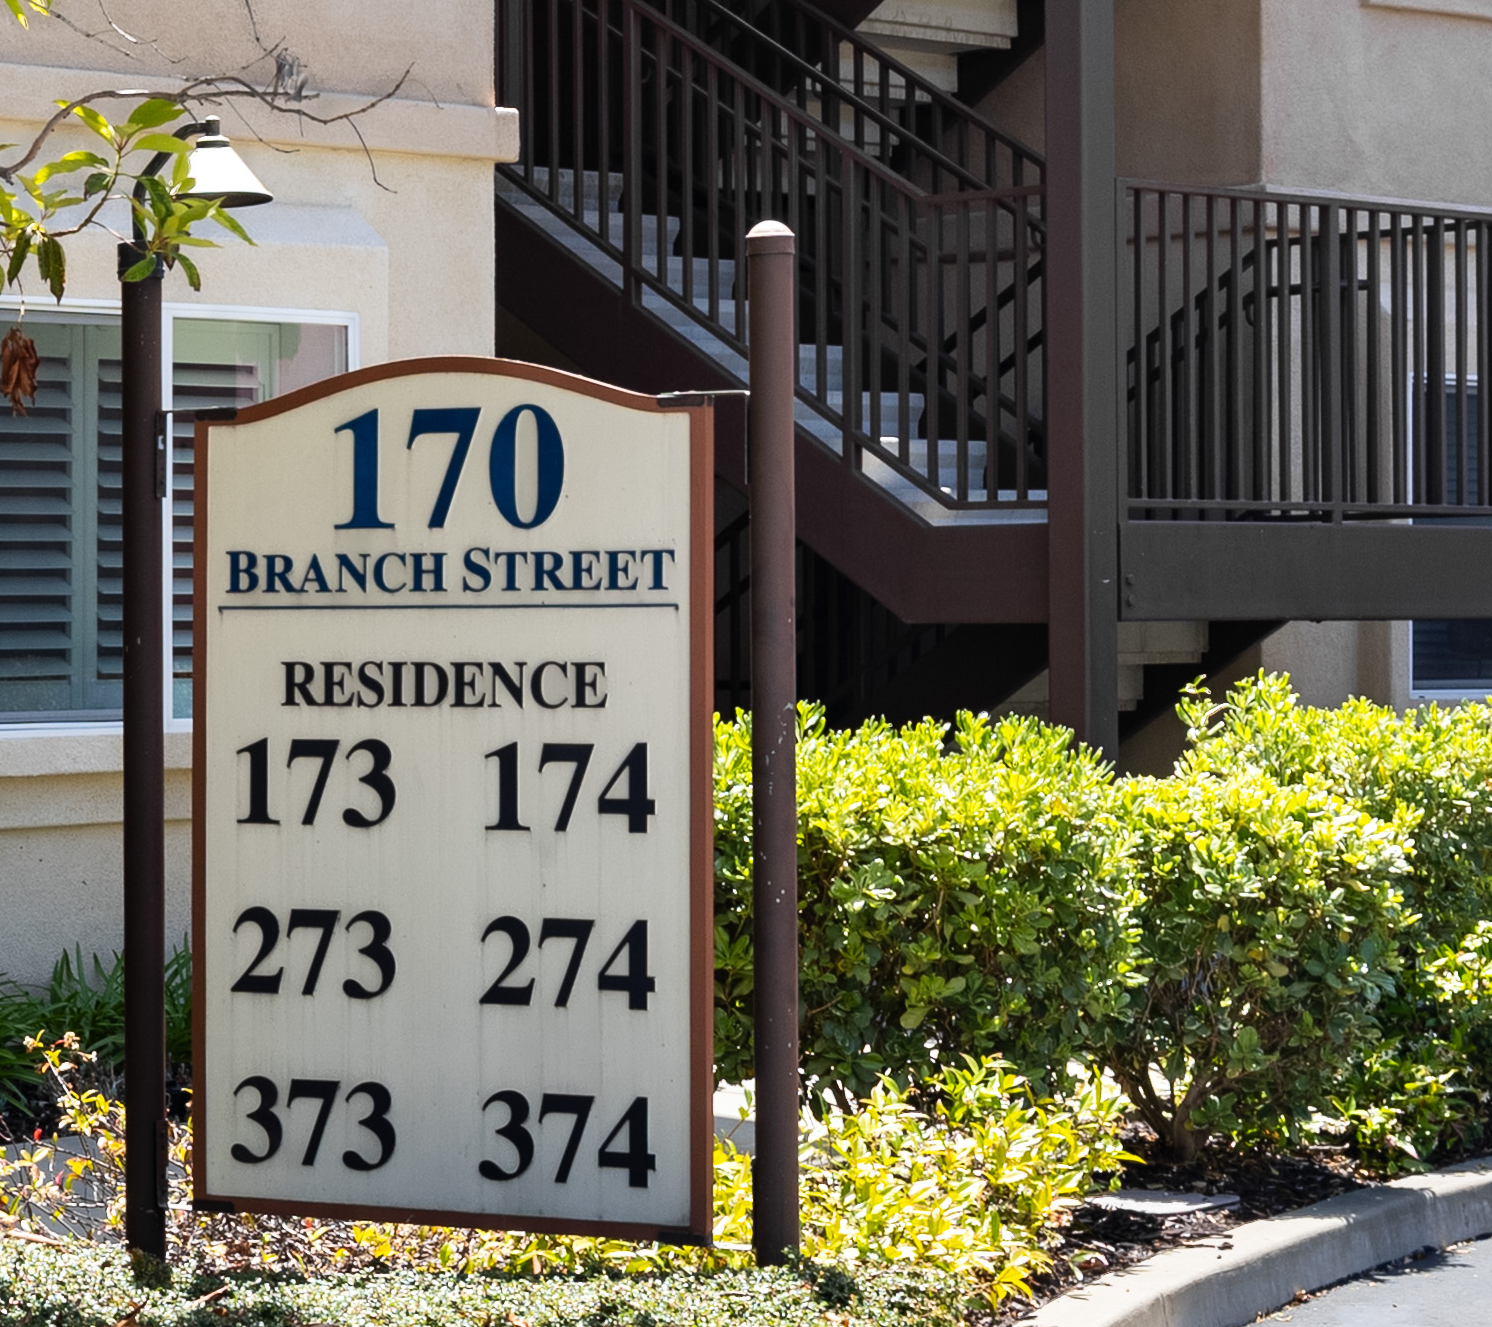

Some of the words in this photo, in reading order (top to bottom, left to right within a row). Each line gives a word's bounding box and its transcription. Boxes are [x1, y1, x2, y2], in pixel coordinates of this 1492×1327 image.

[333, 403, 565, 532] 170
[225, 550, 449, 596] BRANCH
[462, 546, 676, 594] STREET
[280, 660, 608, 710] RESIDENCE
[235, 736, 397, 830] 173
[484, 741, 656, 834] 174
[230, 906, 397, 1002] 273
[478, 916, 656, 1012] 274
[230, 1075, 397, 1174] 373
[478, 1089, 656, 1190] 374
